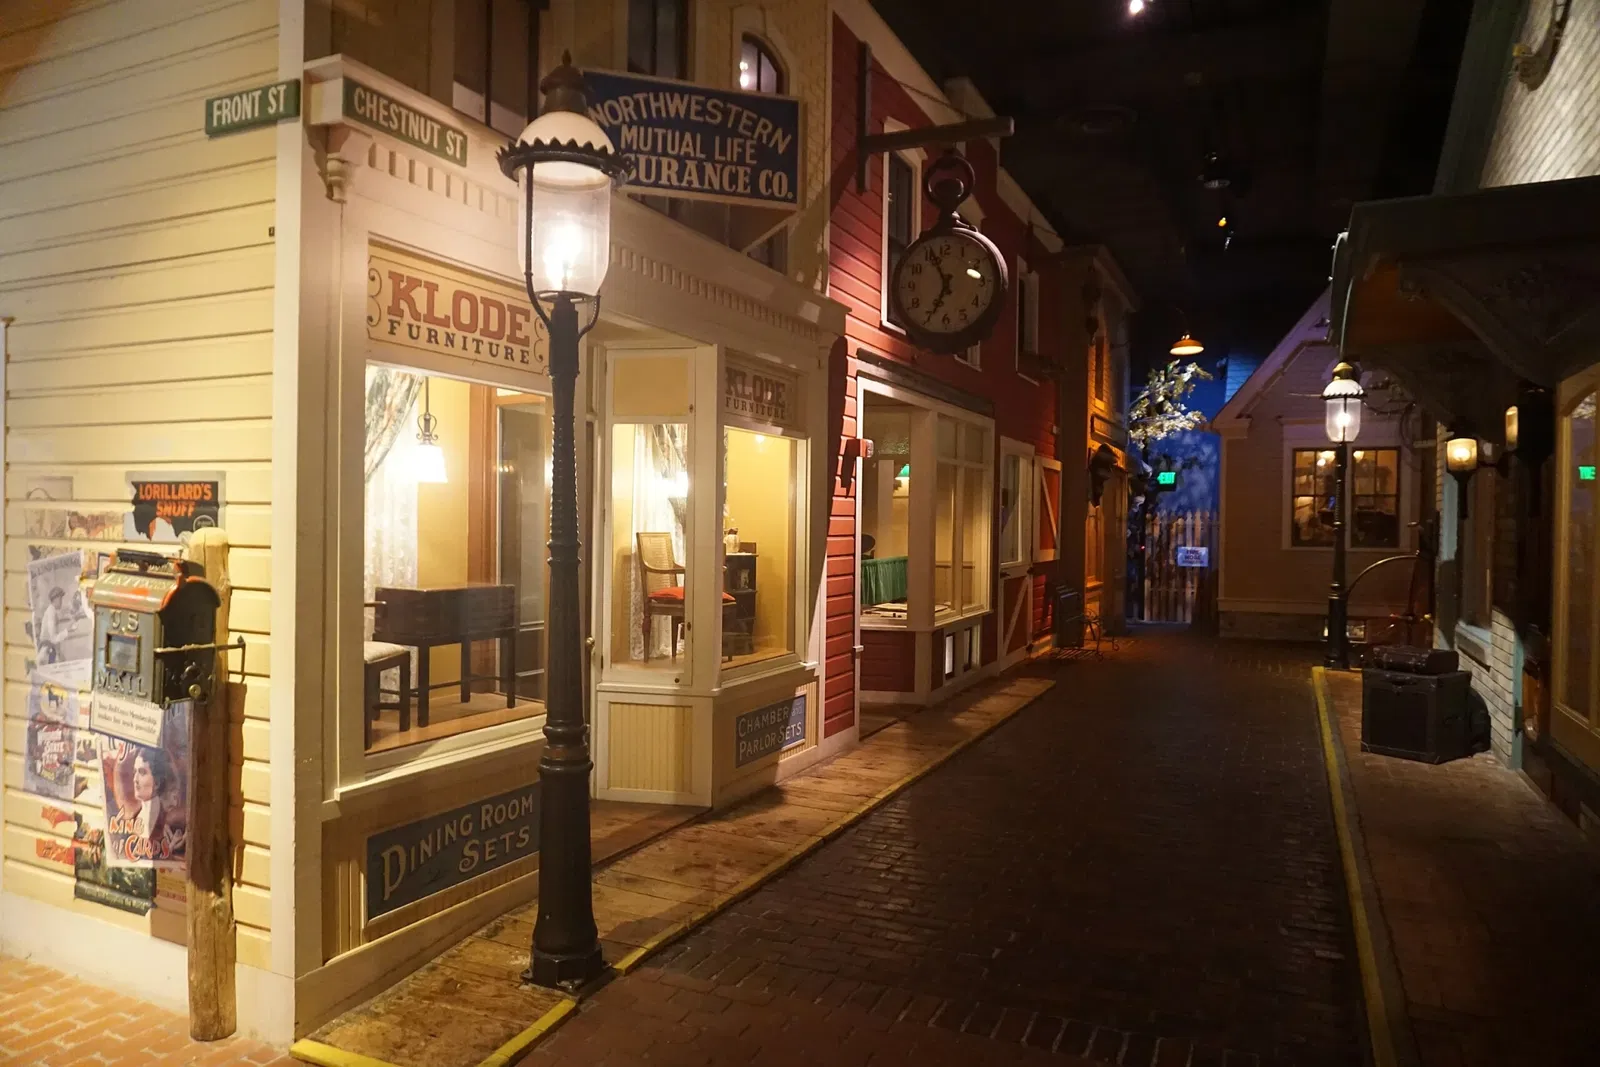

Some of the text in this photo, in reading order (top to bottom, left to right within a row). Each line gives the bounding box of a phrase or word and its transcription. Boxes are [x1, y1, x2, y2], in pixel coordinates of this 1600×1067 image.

[212, 84, 287, 127] FRONT ST
[353, 87, 464, 160] CHESTNUT ST
[587, 91, 792, 155] NORTHWESTERN
[620, 124, 757, 165] MUTUAL LIFE
[758, 168, 794, 199] CO.
[387, 270, 531, 348] KLODE
[388, 318, 530, 365] FURNITURE
[725, 366, 786, 408] KLODE
[725, 397, 785, 419] FURNITURE
[139, 483, 212, 500] LORILLARD'S
[155, 501, 196, 517] SNUFF
[97, 670, 148, 698] MAIL
[738, 706, 790, 738] CHAMBER
[739, 722, 802, 760] PARLOR SETS
[380, 794, 534, 900] DINING ROOM
[458, 825, 530, 873] SETS
